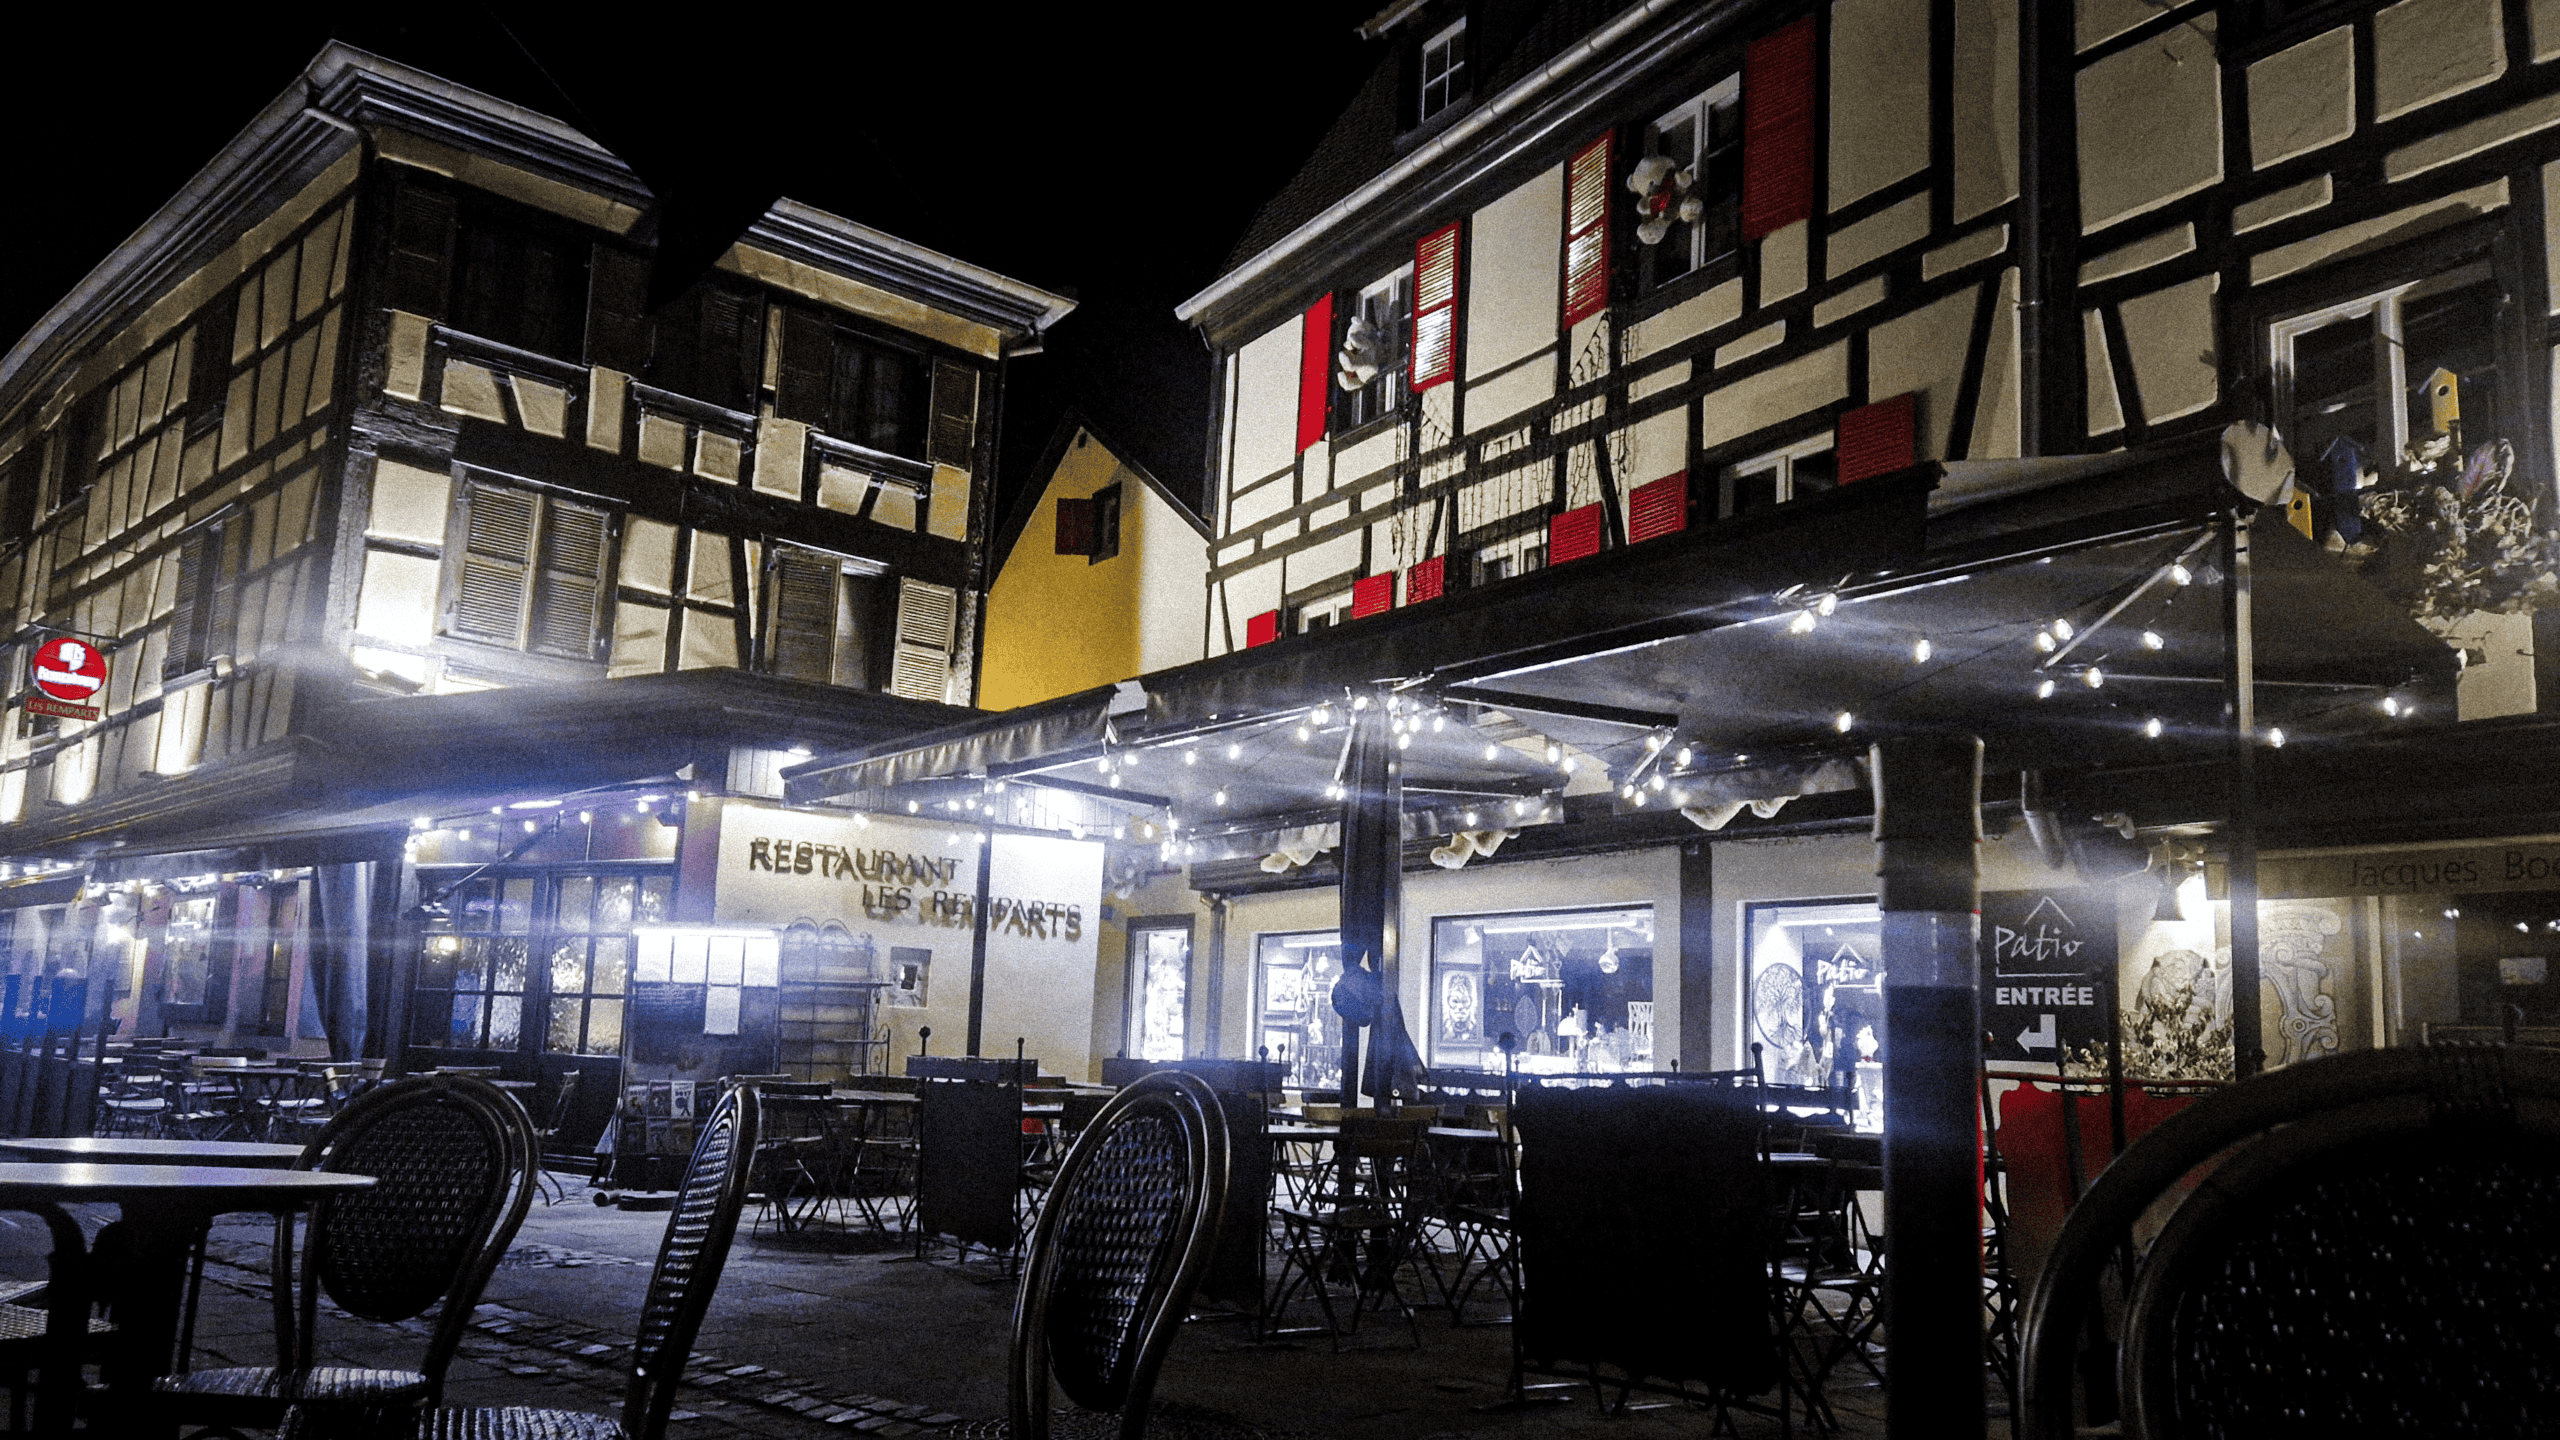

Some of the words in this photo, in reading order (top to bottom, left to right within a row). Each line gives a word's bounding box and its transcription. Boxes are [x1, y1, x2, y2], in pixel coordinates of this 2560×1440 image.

[750, 837, 963, 882] RESTAURANT
[2350, 860, 2478, 892] Jacques
[861, 884, 912, 913] LES
[1994, 924, 2085, 964] Patio
[1816, 958, 1870, 985] Patio
[1995, 982, 2094, 1006] ENTRÉE
